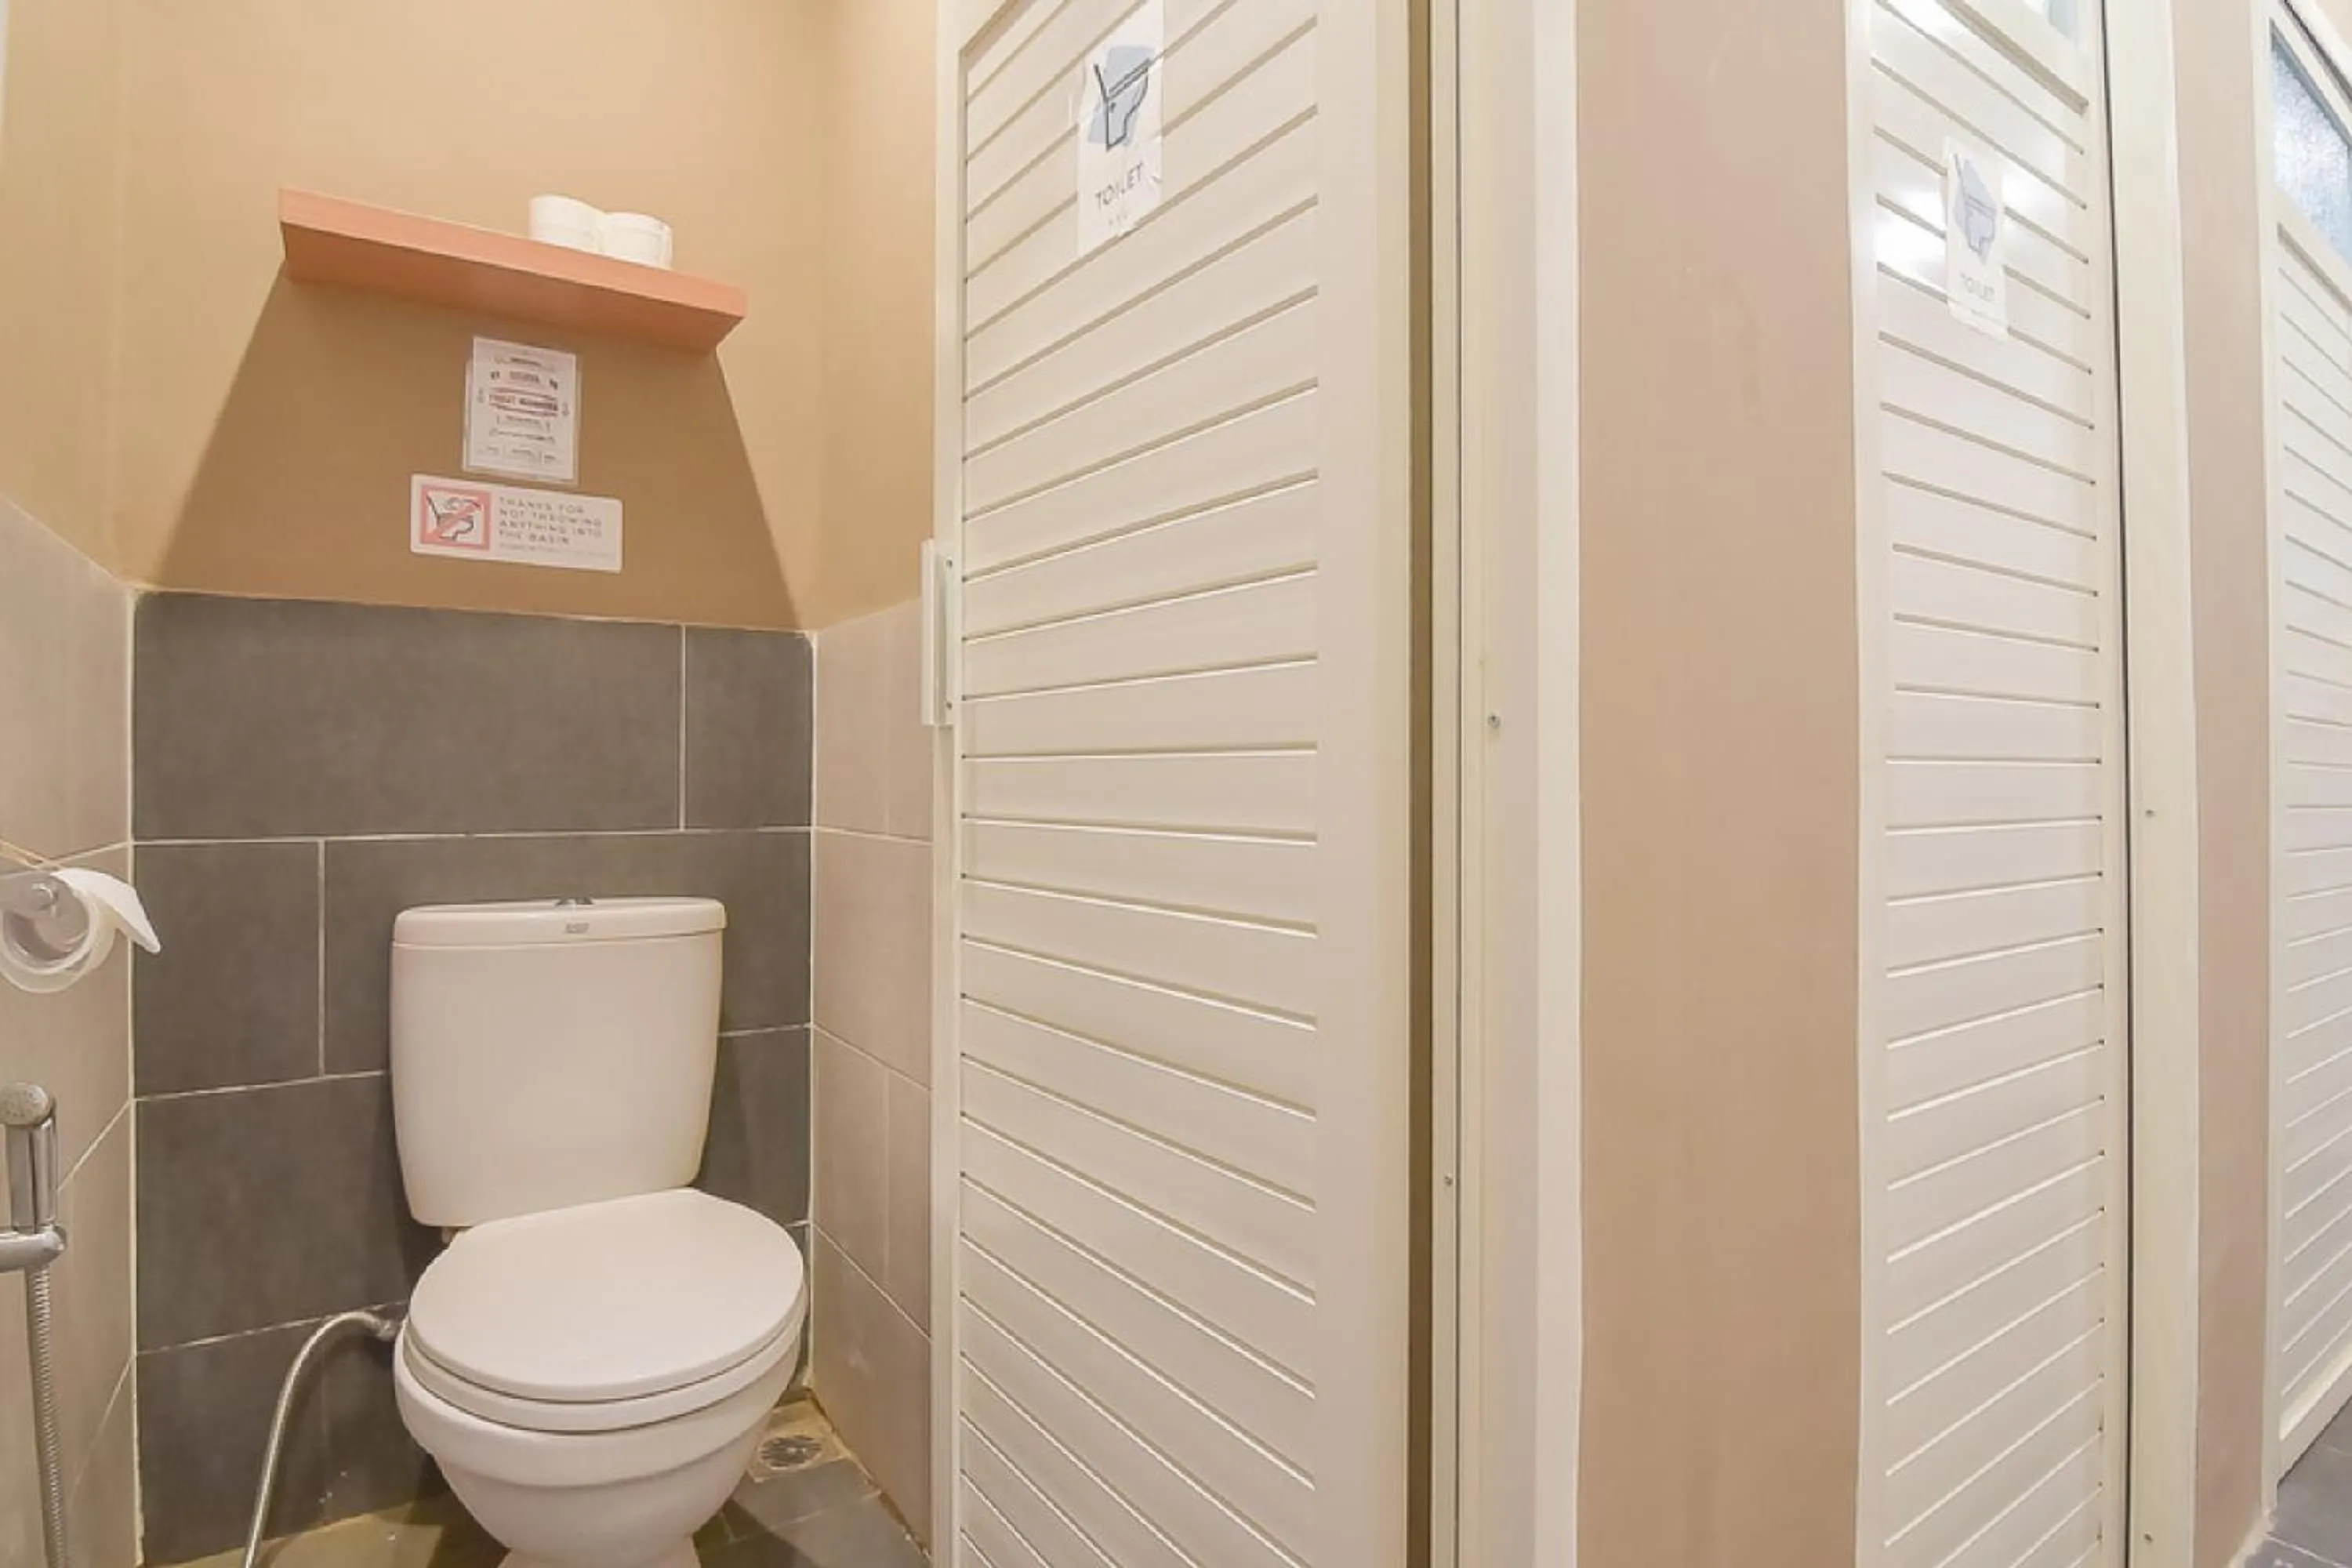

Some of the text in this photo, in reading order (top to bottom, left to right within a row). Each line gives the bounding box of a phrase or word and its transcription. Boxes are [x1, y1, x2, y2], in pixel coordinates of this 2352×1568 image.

[1094, 161, 1143, 211] TOILET
[499, 496, 584, 514] THANKS FOR
[499, 508, 602, 528] NOT THROWING
[499, 520, 602, 539] ANYTHING INTO
[499, 529, 569, 545] THE BASIN
